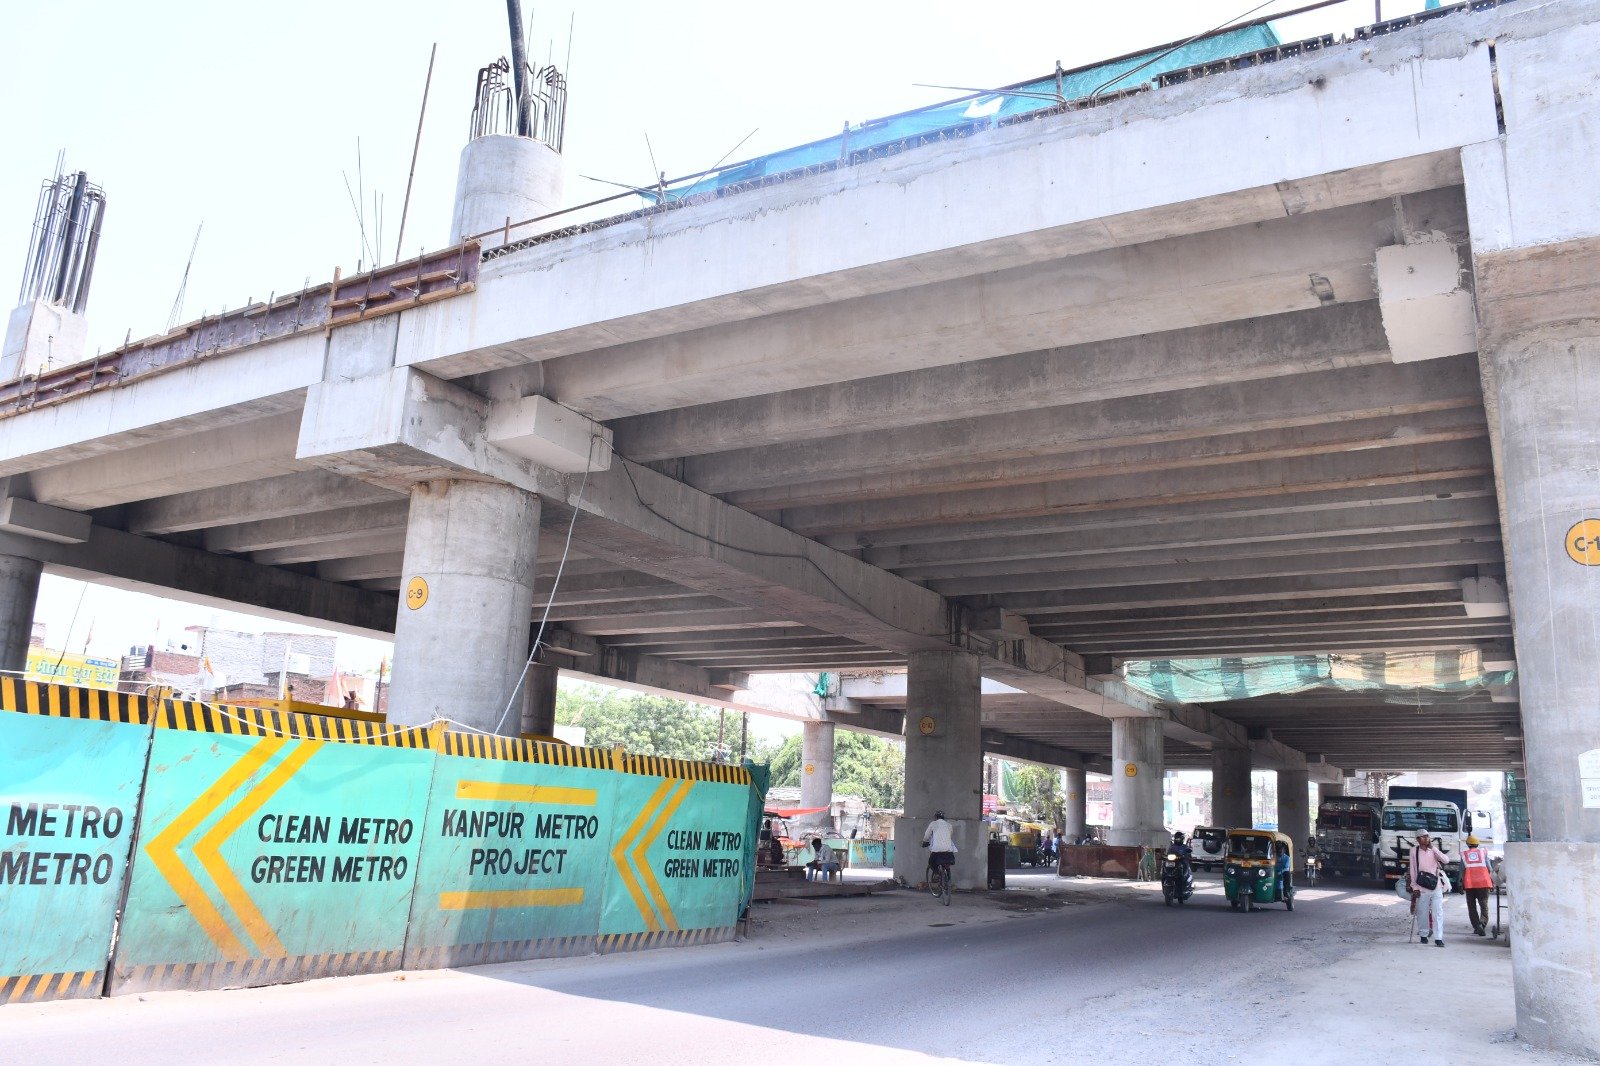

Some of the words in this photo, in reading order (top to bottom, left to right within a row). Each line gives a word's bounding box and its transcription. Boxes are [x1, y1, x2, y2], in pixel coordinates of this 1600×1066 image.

[408, 588, 423, 599] C-9
[6, 802, 123, 839] METRO
[258, 814, 331, 844] CLEAN
[338, 817, 413, 845] METRO
[442, 809, 524, 839] KANPUR
[535, 814, 599, 840] METRO
[667, 830, 701, 851] CLEAN
[705, 831, 742, 851] METRO
[0, 851, 113, 885] METRO
[251, 856, 326, 884] GREEN
[332, 855, 408, 883] METRO
[469, 848, 567, 876] PROJECT
[664, 859, 699, 879] GREEN
[702, 858, 739, 879] METRO
